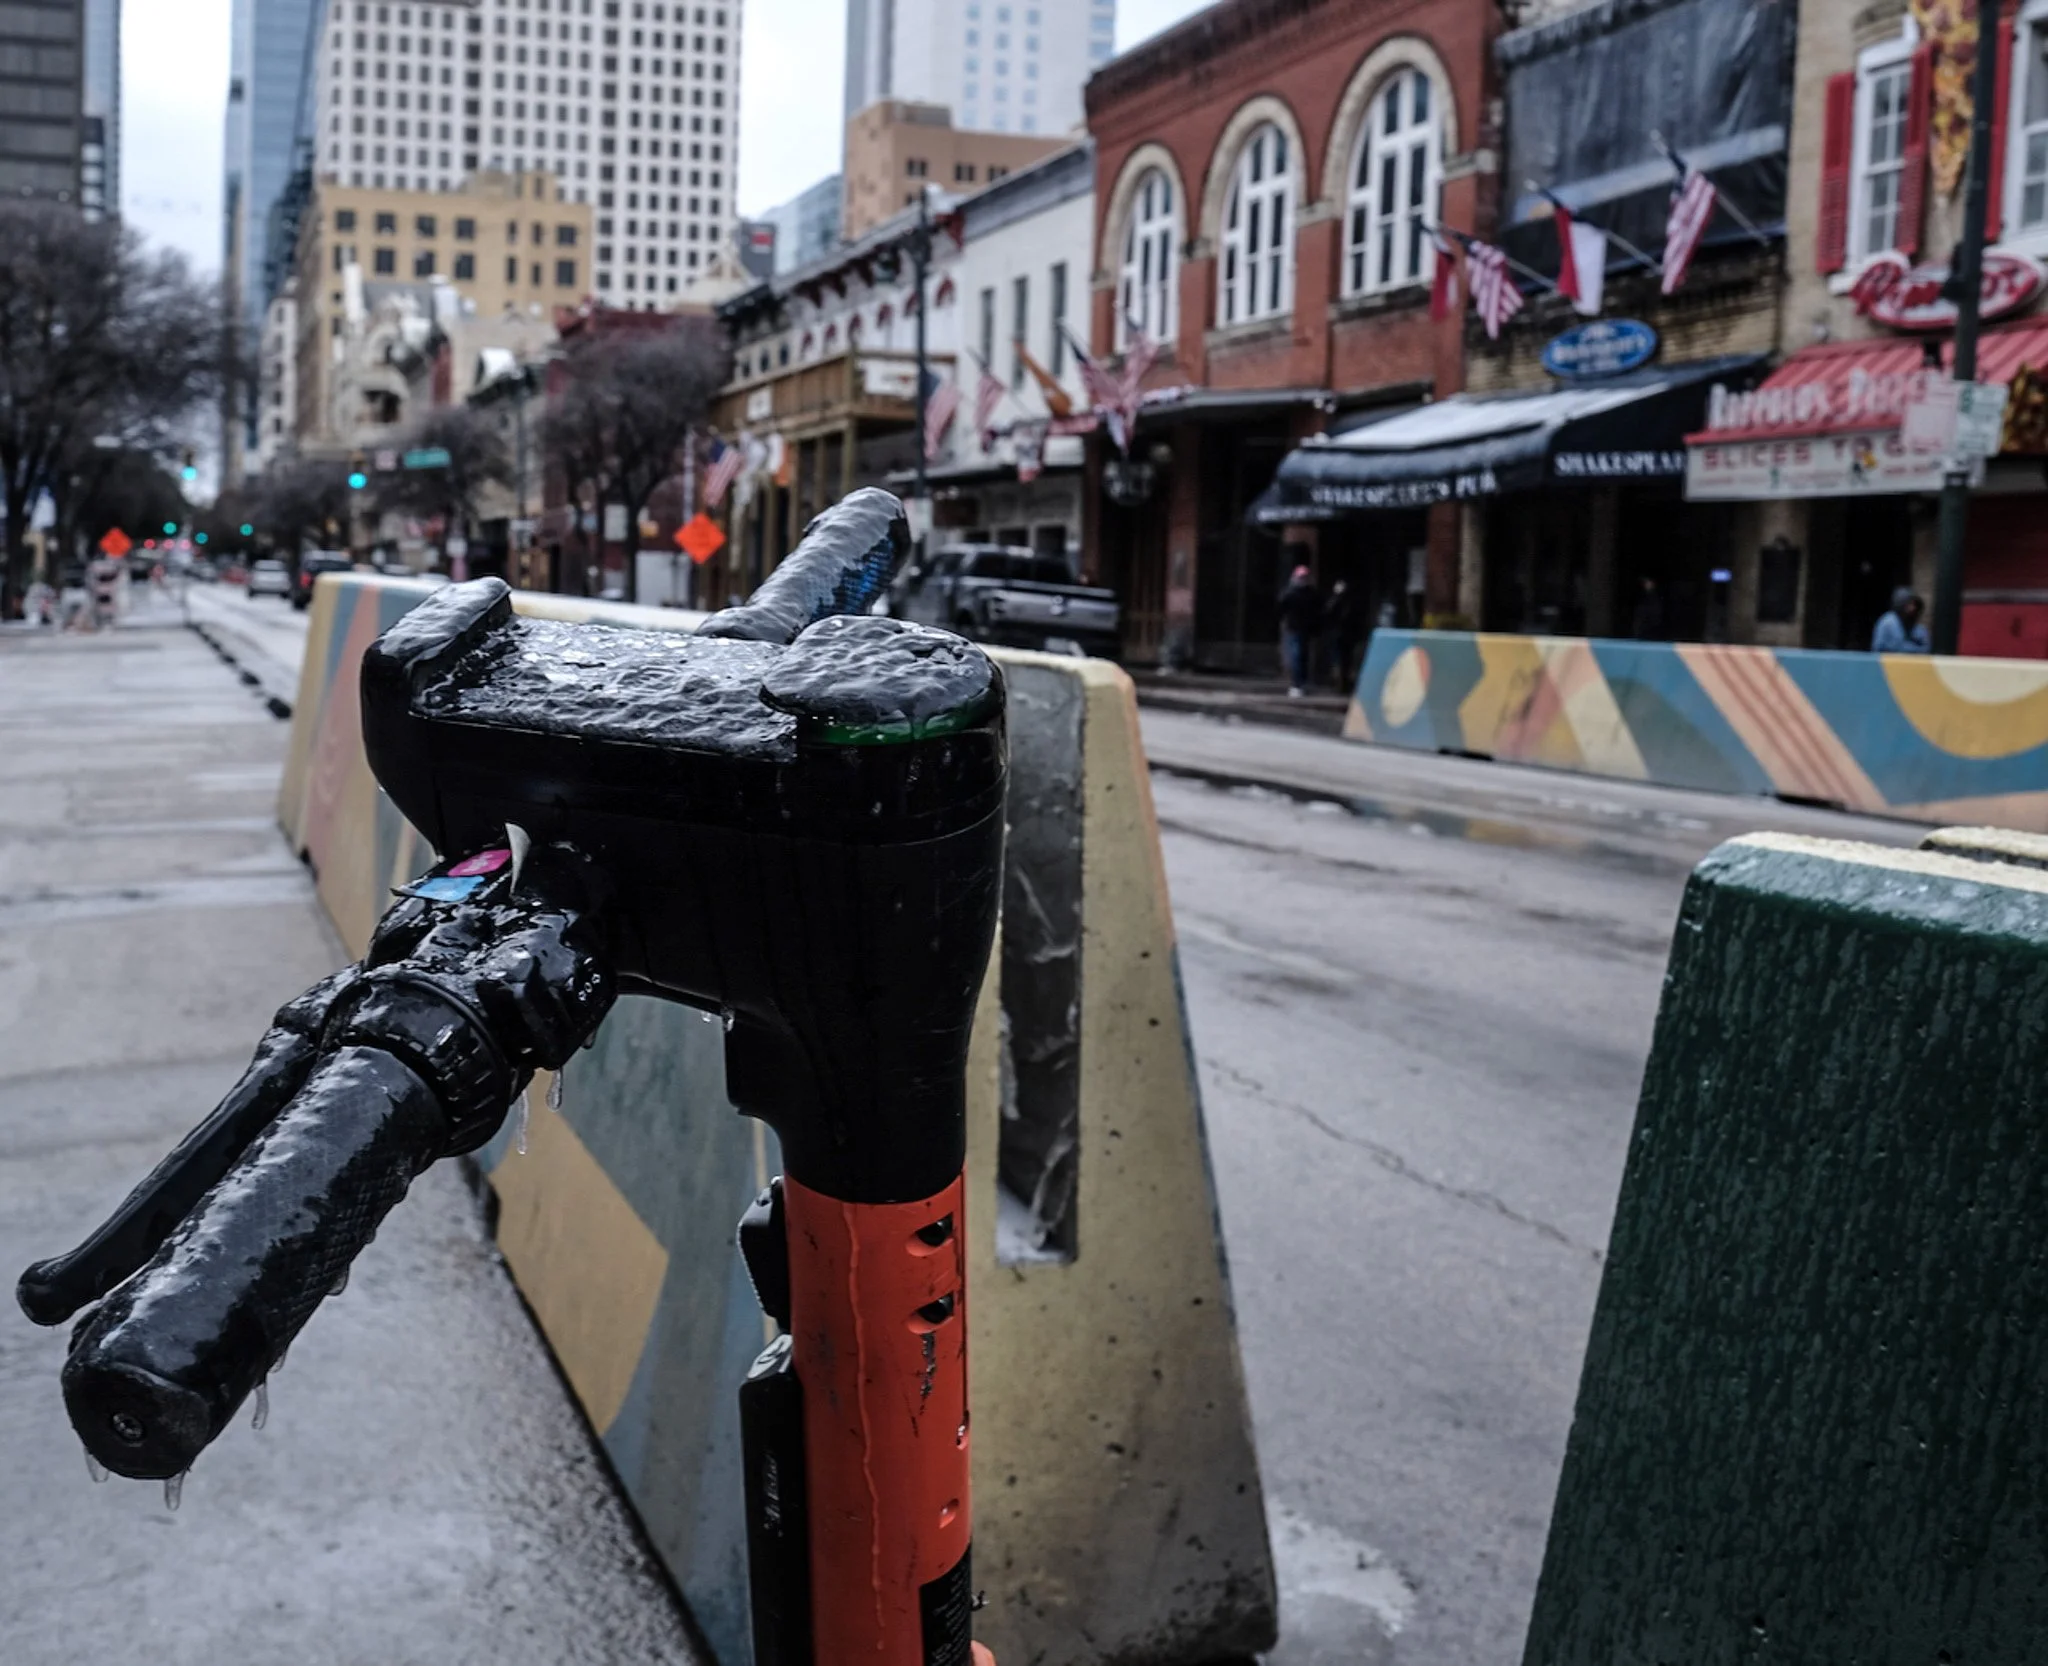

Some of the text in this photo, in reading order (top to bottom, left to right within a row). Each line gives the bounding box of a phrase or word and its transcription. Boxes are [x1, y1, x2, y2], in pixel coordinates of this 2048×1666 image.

[1702, 440, 1811, 470] SLICES
[1832, 436, 1874, 459] TO
[1455, 470, 1497, 498] PUB
